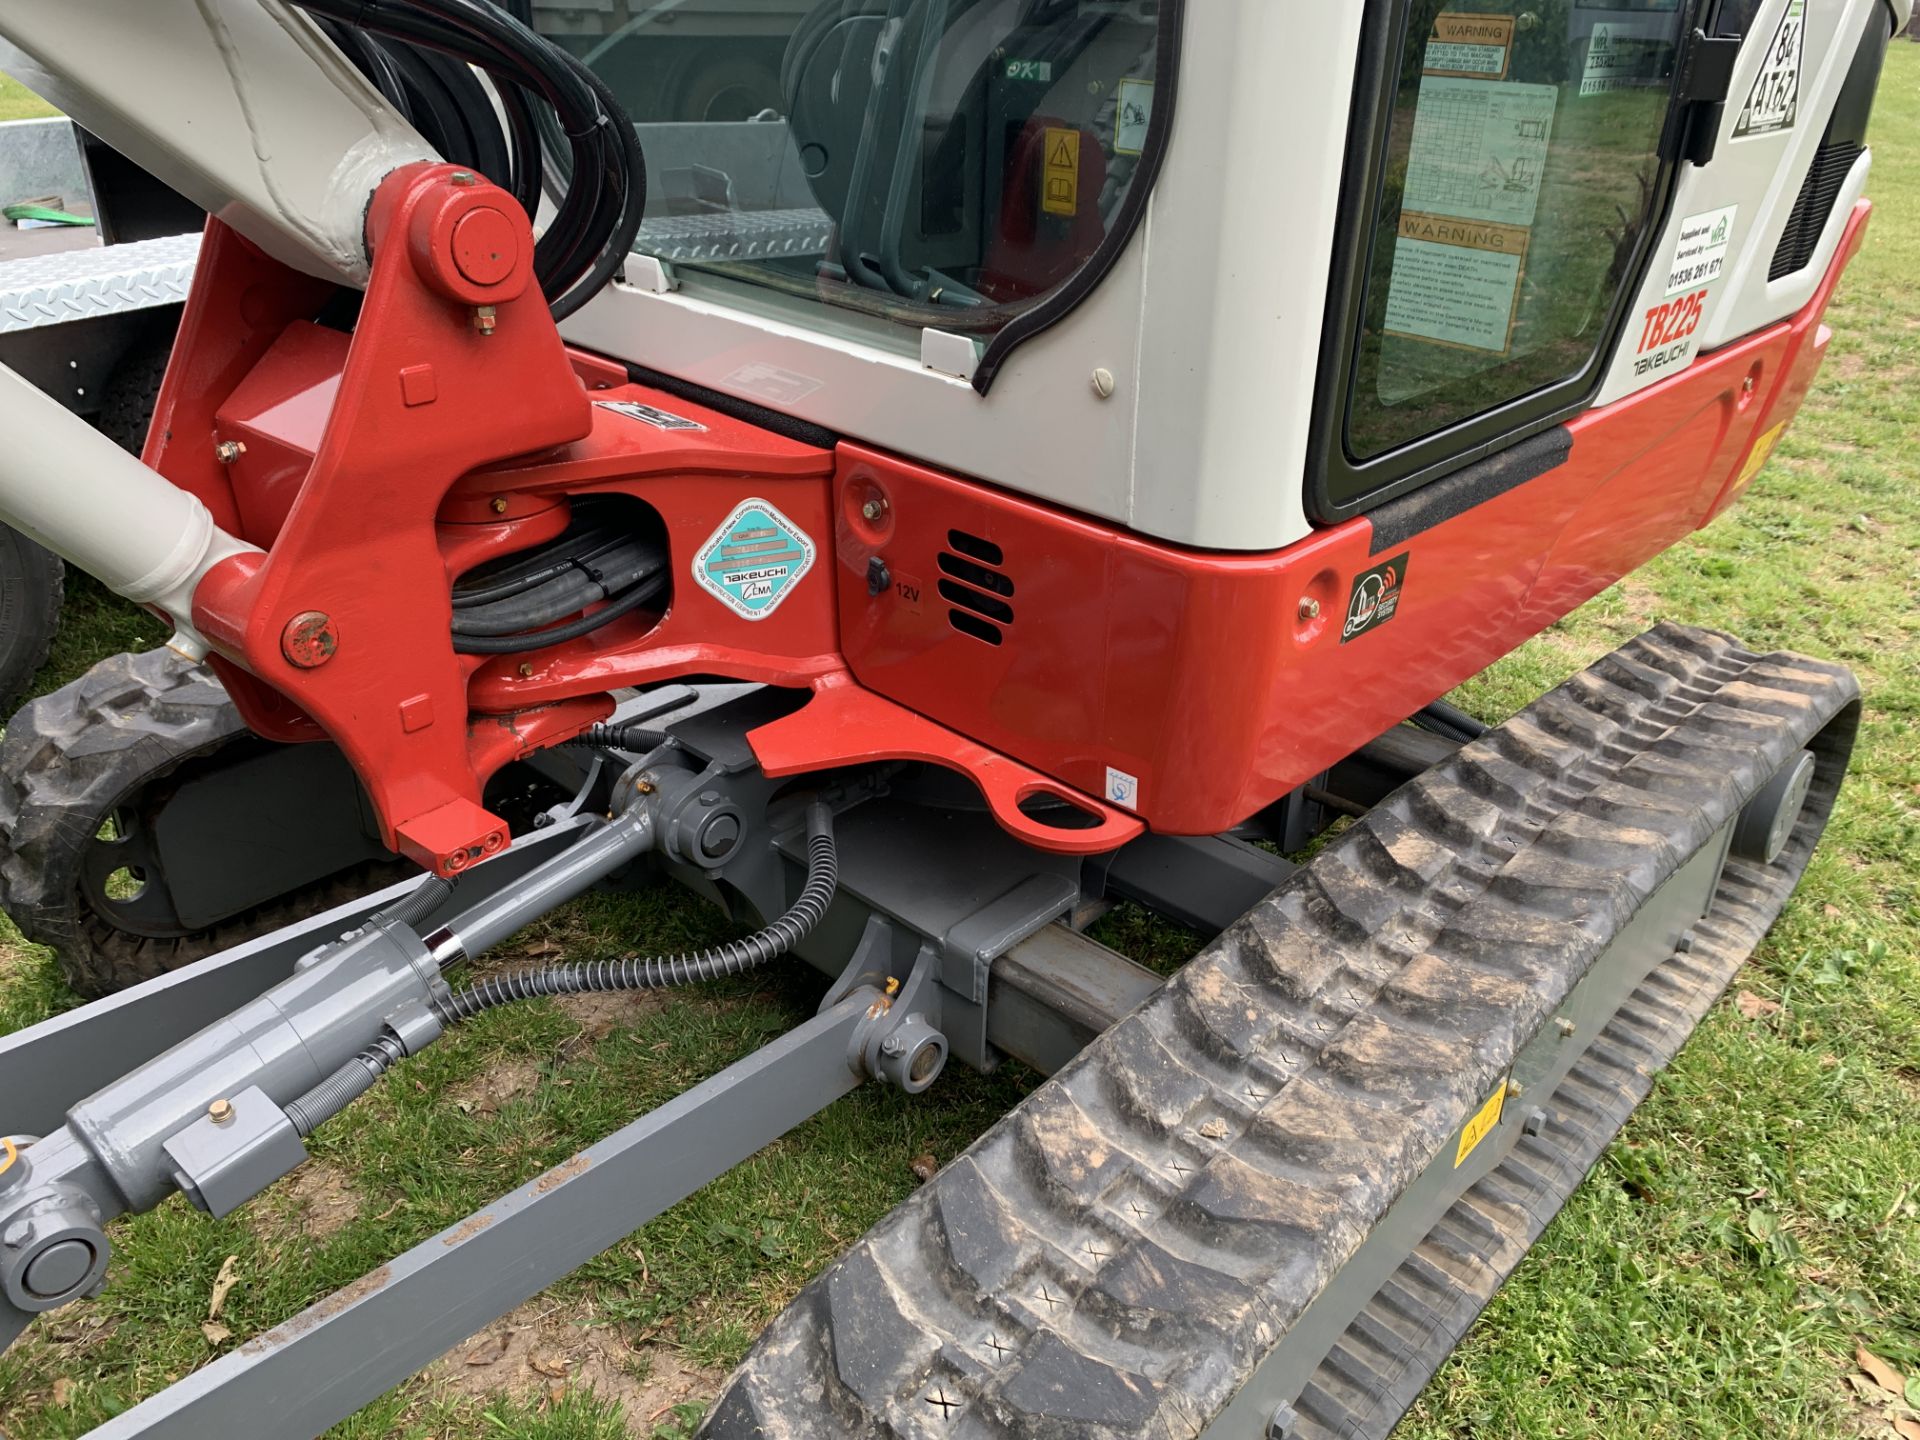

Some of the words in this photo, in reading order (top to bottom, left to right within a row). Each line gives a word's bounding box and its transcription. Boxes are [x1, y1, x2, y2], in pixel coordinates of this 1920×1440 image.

[1447, 25, 1502, 38] WARNING
[1776, 22, 1799, 66] 84
[1405, 220, 1504, 248] WARNING
[1680, 226, 1701, 241] Supplied
[1701, 224, 1711, 234] and
[1677, 246, 1698, 260] Serviced
[1668, 266, 1693, 288] 01536
[1693, 262, 1709, 280] 261
[1637, 288, 1708, 354] TB225
[701, 537, 723, 560] Certificate
[726, 520, 736, 530] New
[736, 504, 770, 520] Construction
[769, 512, 788, 530] Machine
[793, 532, 809, 548] Export
[896, 582, 920, 602] 12V
